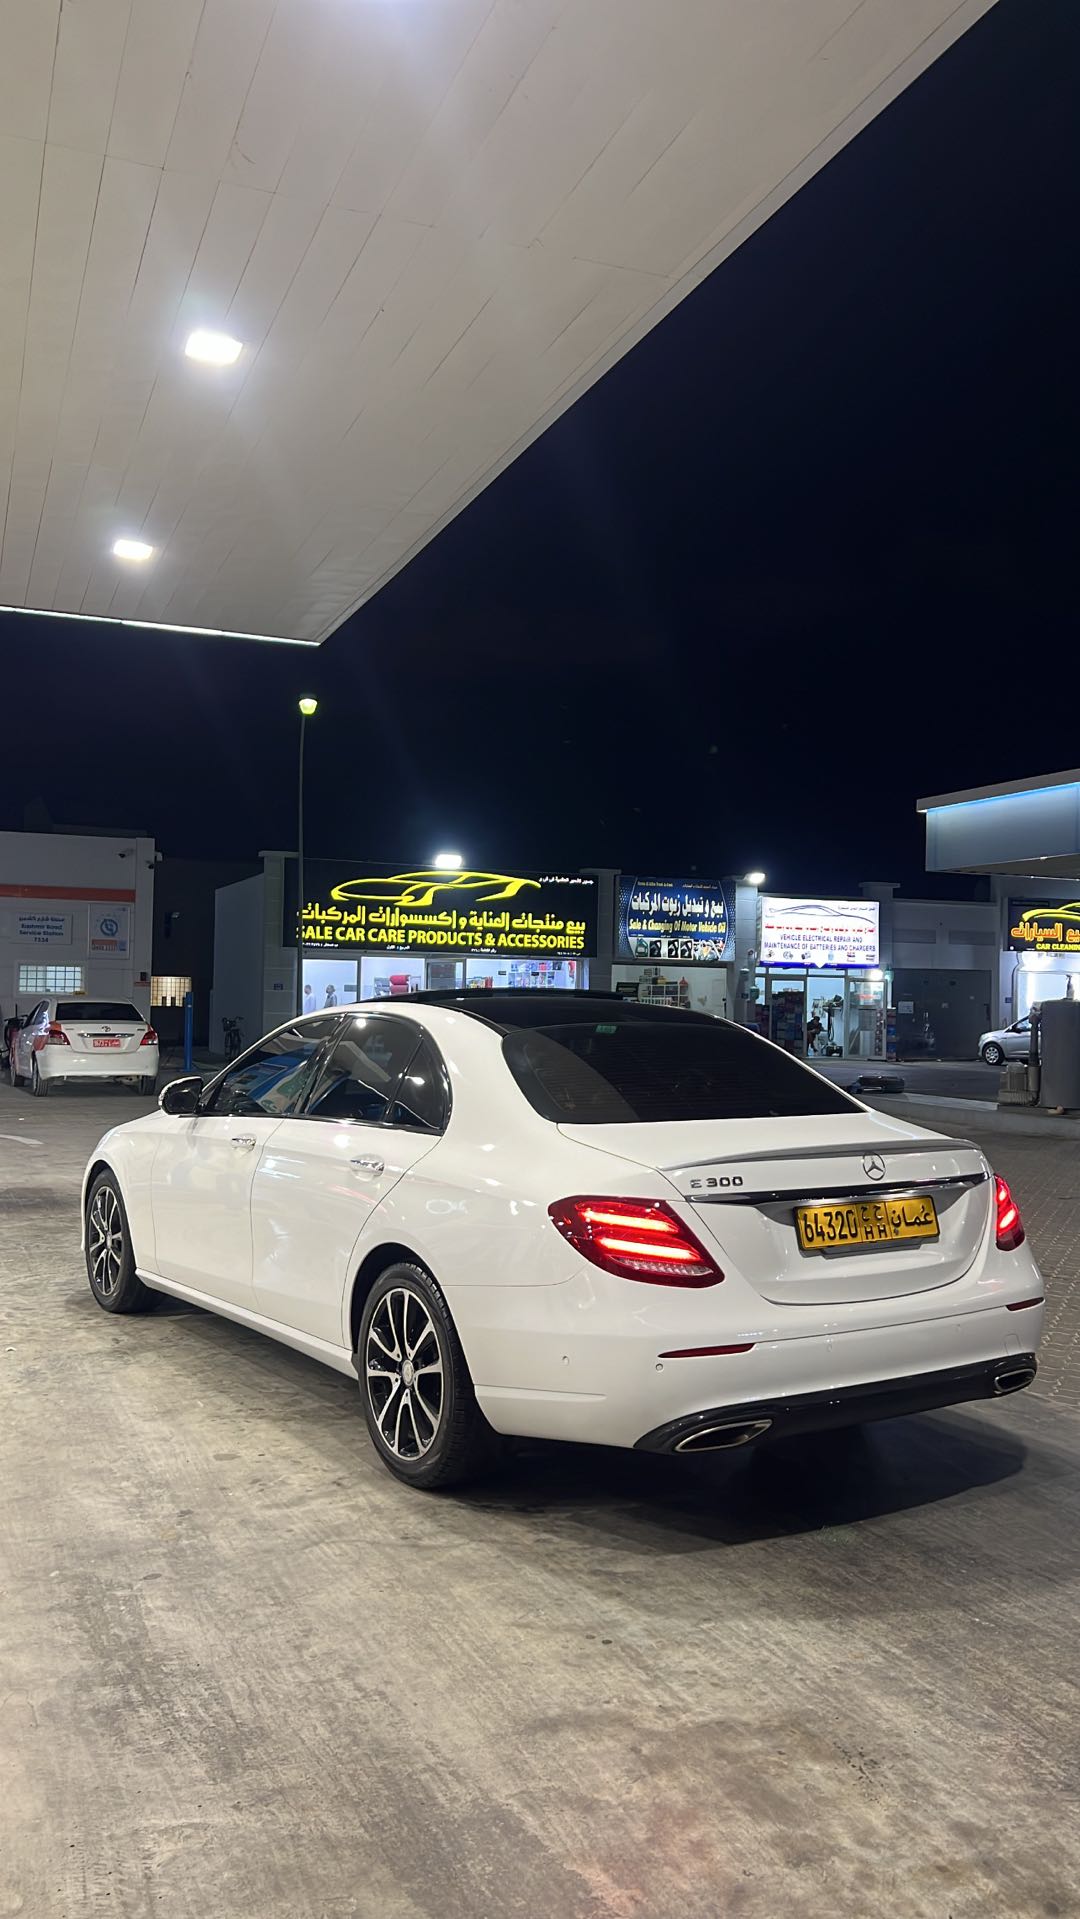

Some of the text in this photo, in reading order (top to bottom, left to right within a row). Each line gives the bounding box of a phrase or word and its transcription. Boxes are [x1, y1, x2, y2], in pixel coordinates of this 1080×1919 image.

[631, 891, 661, 915] المركبات
[661, 894, 681, 917] زيوت
[682, 894, 703, 917] تبديل
[710, 900, 724, 919] بيع
[296, 902, 366, 926] المركبات
[459, 917, 467, 930] و
[469, 910, 510, 932] العناية
[511, 912, 565, 933] منتجات
[566, 920, 586, 935] بيع
[629, 919, 641, 930] Sale
[647, 919, 673, 933] Changing
[681, 921, 698, 932] Motor
[698, 921, 717, 933] Vehicle
[717, 922, 727, 933] Oil
[1011, 921, 1063, 942] السيارات
[296, 925, 585, 950] SALE CAR CARE PRODUCTS & ACCESSORIES
[764, 941, 801, 950] MAINTENANCE
[801, 942, 809, 950] OF
[809, 943, 837, 951] BATTERIES
[837, 944, 849, 952] AND
[780, 934, 802, 942] VEHICLE
[802, 935, 833, 943] ELECTRICAL
[833, 936, 851, 944] REPAIR
[690, 1176, 743, 1188] E 300
[803, 1209, 858, 1242] 64320
